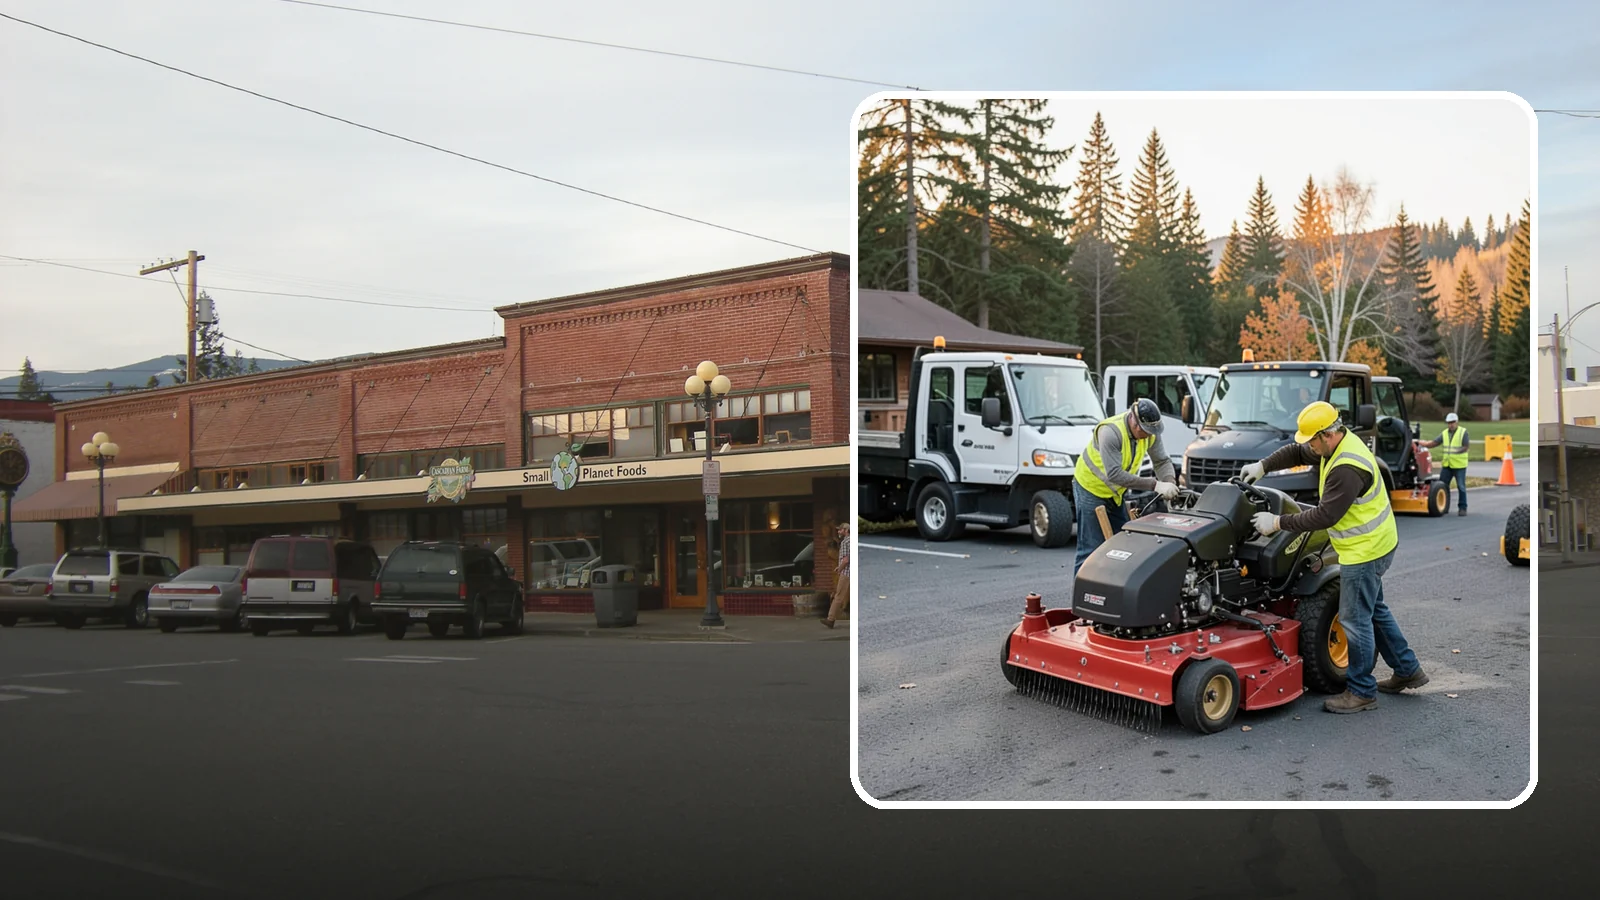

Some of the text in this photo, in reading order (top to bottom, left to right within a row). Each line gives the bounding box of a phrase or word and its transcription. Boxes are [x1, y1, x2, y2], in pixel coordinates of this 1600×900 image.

[431, 465, 456, 476] CASCADIAN
[522, 464, 647, 483] Small Planet Foods
